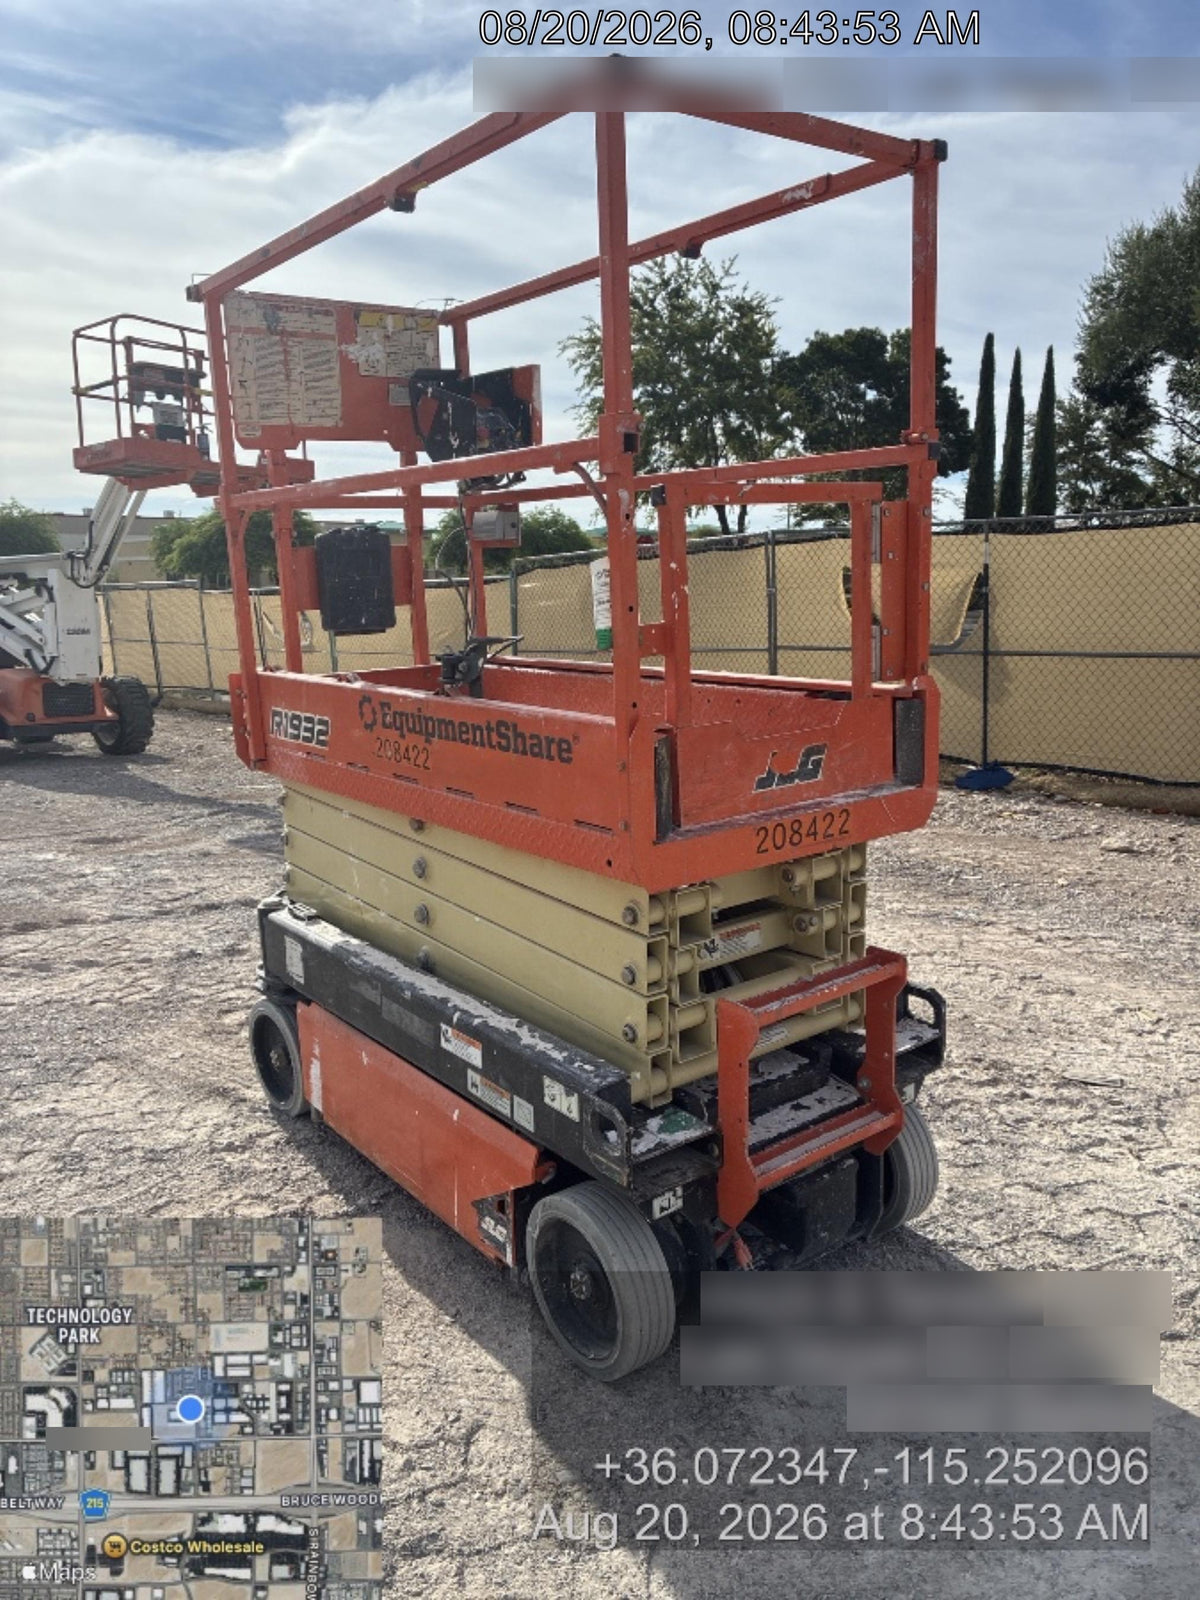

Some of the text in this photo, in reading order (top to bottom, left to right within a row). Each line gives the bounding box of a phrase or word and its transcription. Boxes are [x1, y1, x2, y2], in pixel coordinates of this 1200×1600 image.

[270, 707, 331, 750] R1932
[374, 737, 431, 770] 208422
[756, 808, 850, 854] 208422
